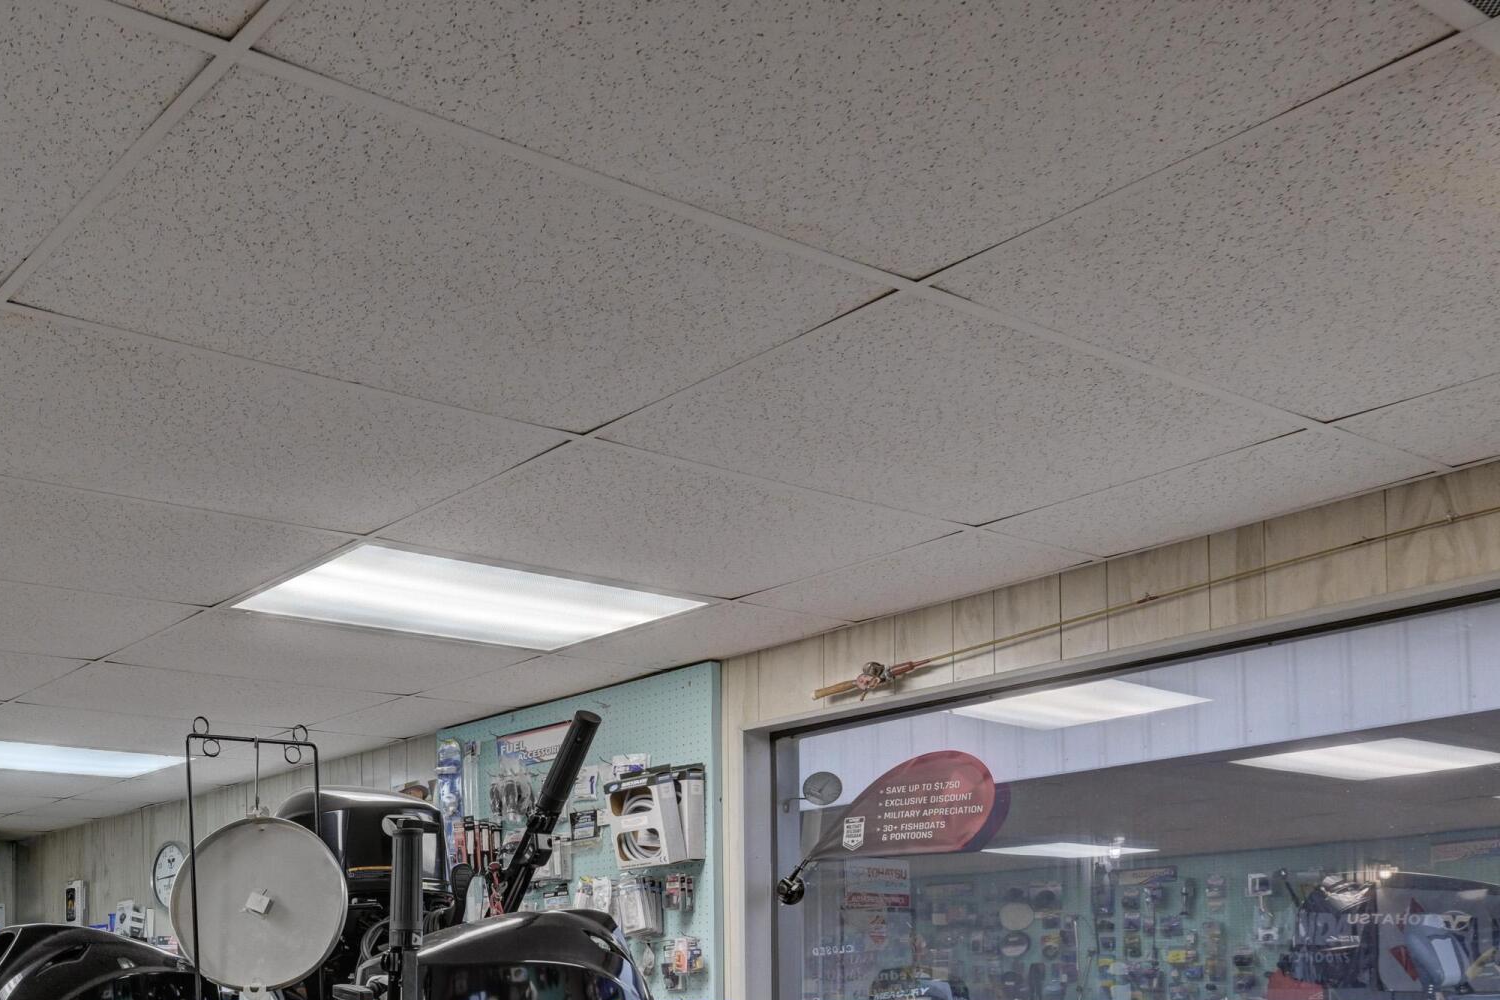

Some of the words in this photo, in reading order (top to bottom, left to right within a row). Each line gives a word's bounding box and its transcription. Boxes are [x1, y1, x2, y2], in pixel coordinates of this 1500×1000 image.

[501, 740, 525, 755] FUEL
[518, 744, 562, 760] ACCESSORI
[886, 786, 906, 795] SAVE
[908, 784, 920, 793] UP
[922, 783, 932, 791] TO
[884, 796, 928, 807] EXCLUSIVE
[930, 792, 973, 803] DISCOUNT
[883, 810, 921, 820] MILITARY
[922, 805, 984, 817] APPRECIATION
[882, 824, 898, 833] 30+
[900, 821, 946, 831] FISHBOATS
[889, 831, 933, 841] PONTOONS
[867, 868, 907, 880] TOHATSU
